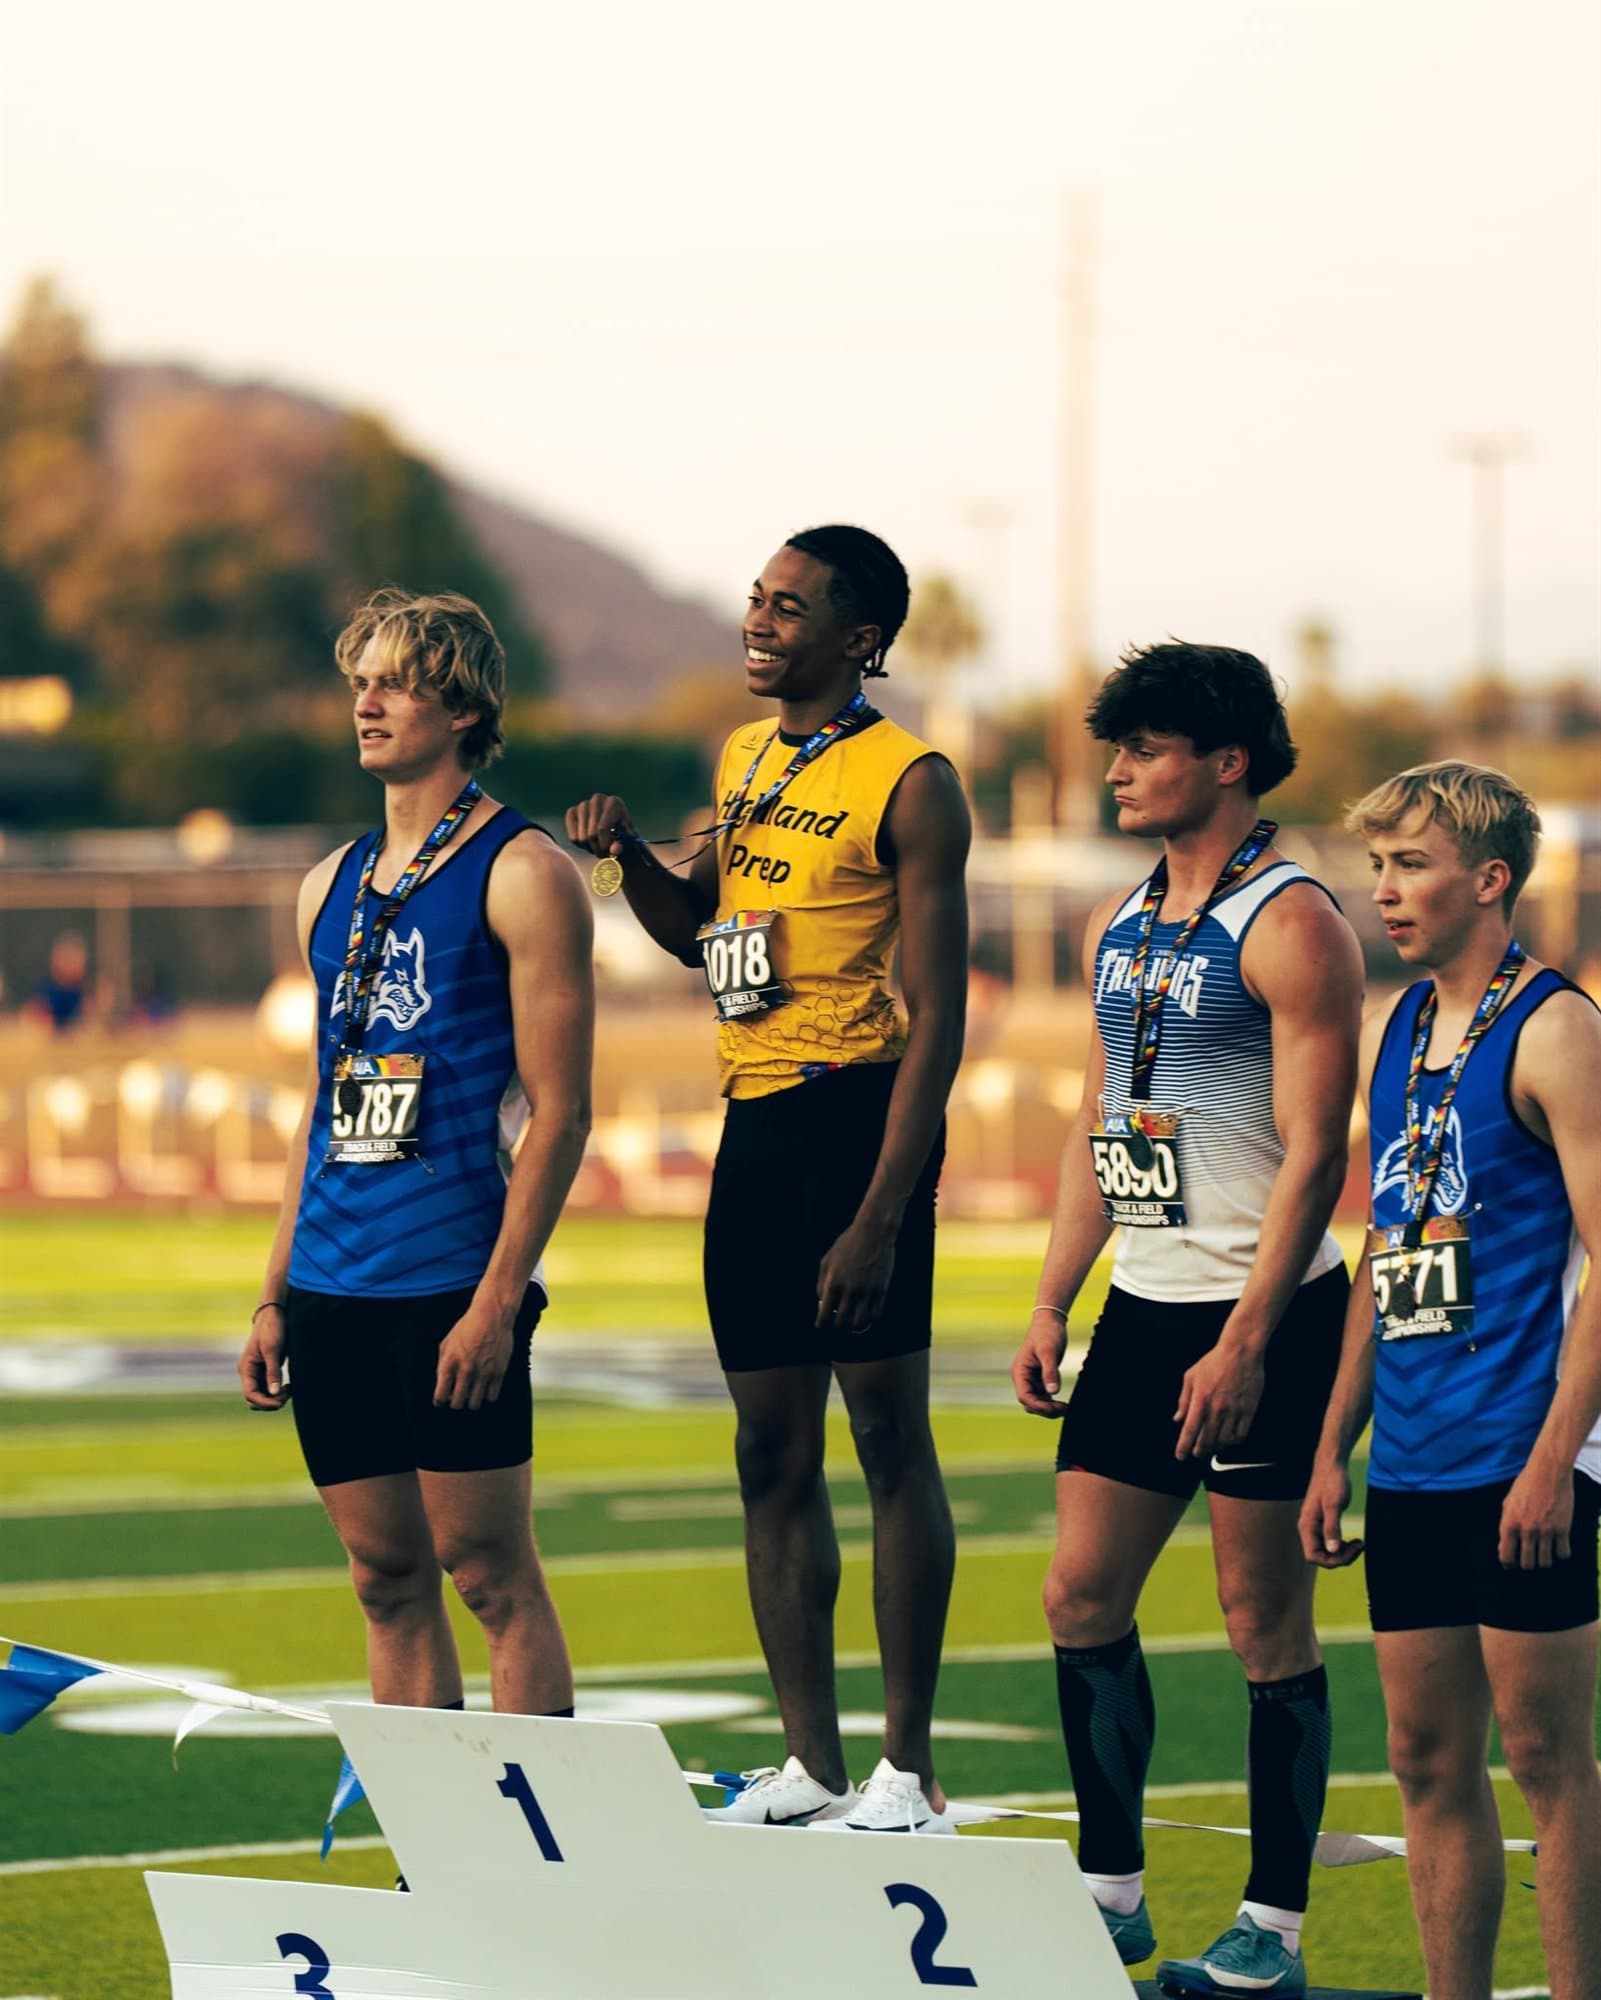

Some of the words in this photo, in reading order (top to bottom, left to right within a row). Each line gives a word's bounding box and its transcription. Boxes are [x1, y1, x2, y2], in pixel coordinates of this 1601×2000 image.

[433, 824, 447, 840] AIA
[726, 844, 791, 889] Prep
[395, 878, 409, 894] AIA
[732, 993, 760, 1005] FIELD
[1481, 995, 1495, 1011] AIA
[355, 1061, 376, 1075] IA
[1105, 1118, 1128, 1132] AIA
[375, 1142, 398, 1152] FIELD
[1138, 1204, 1164, 1215] FIELD
[1389, 1229, 1405, 1246] AI
[1415, 1310, 1447, 1322] FIELD
[495, 1762, 565, 1863] 1
[883, 1881, 979, 1988] 2
[275, 1931, 335, 2000] 3
